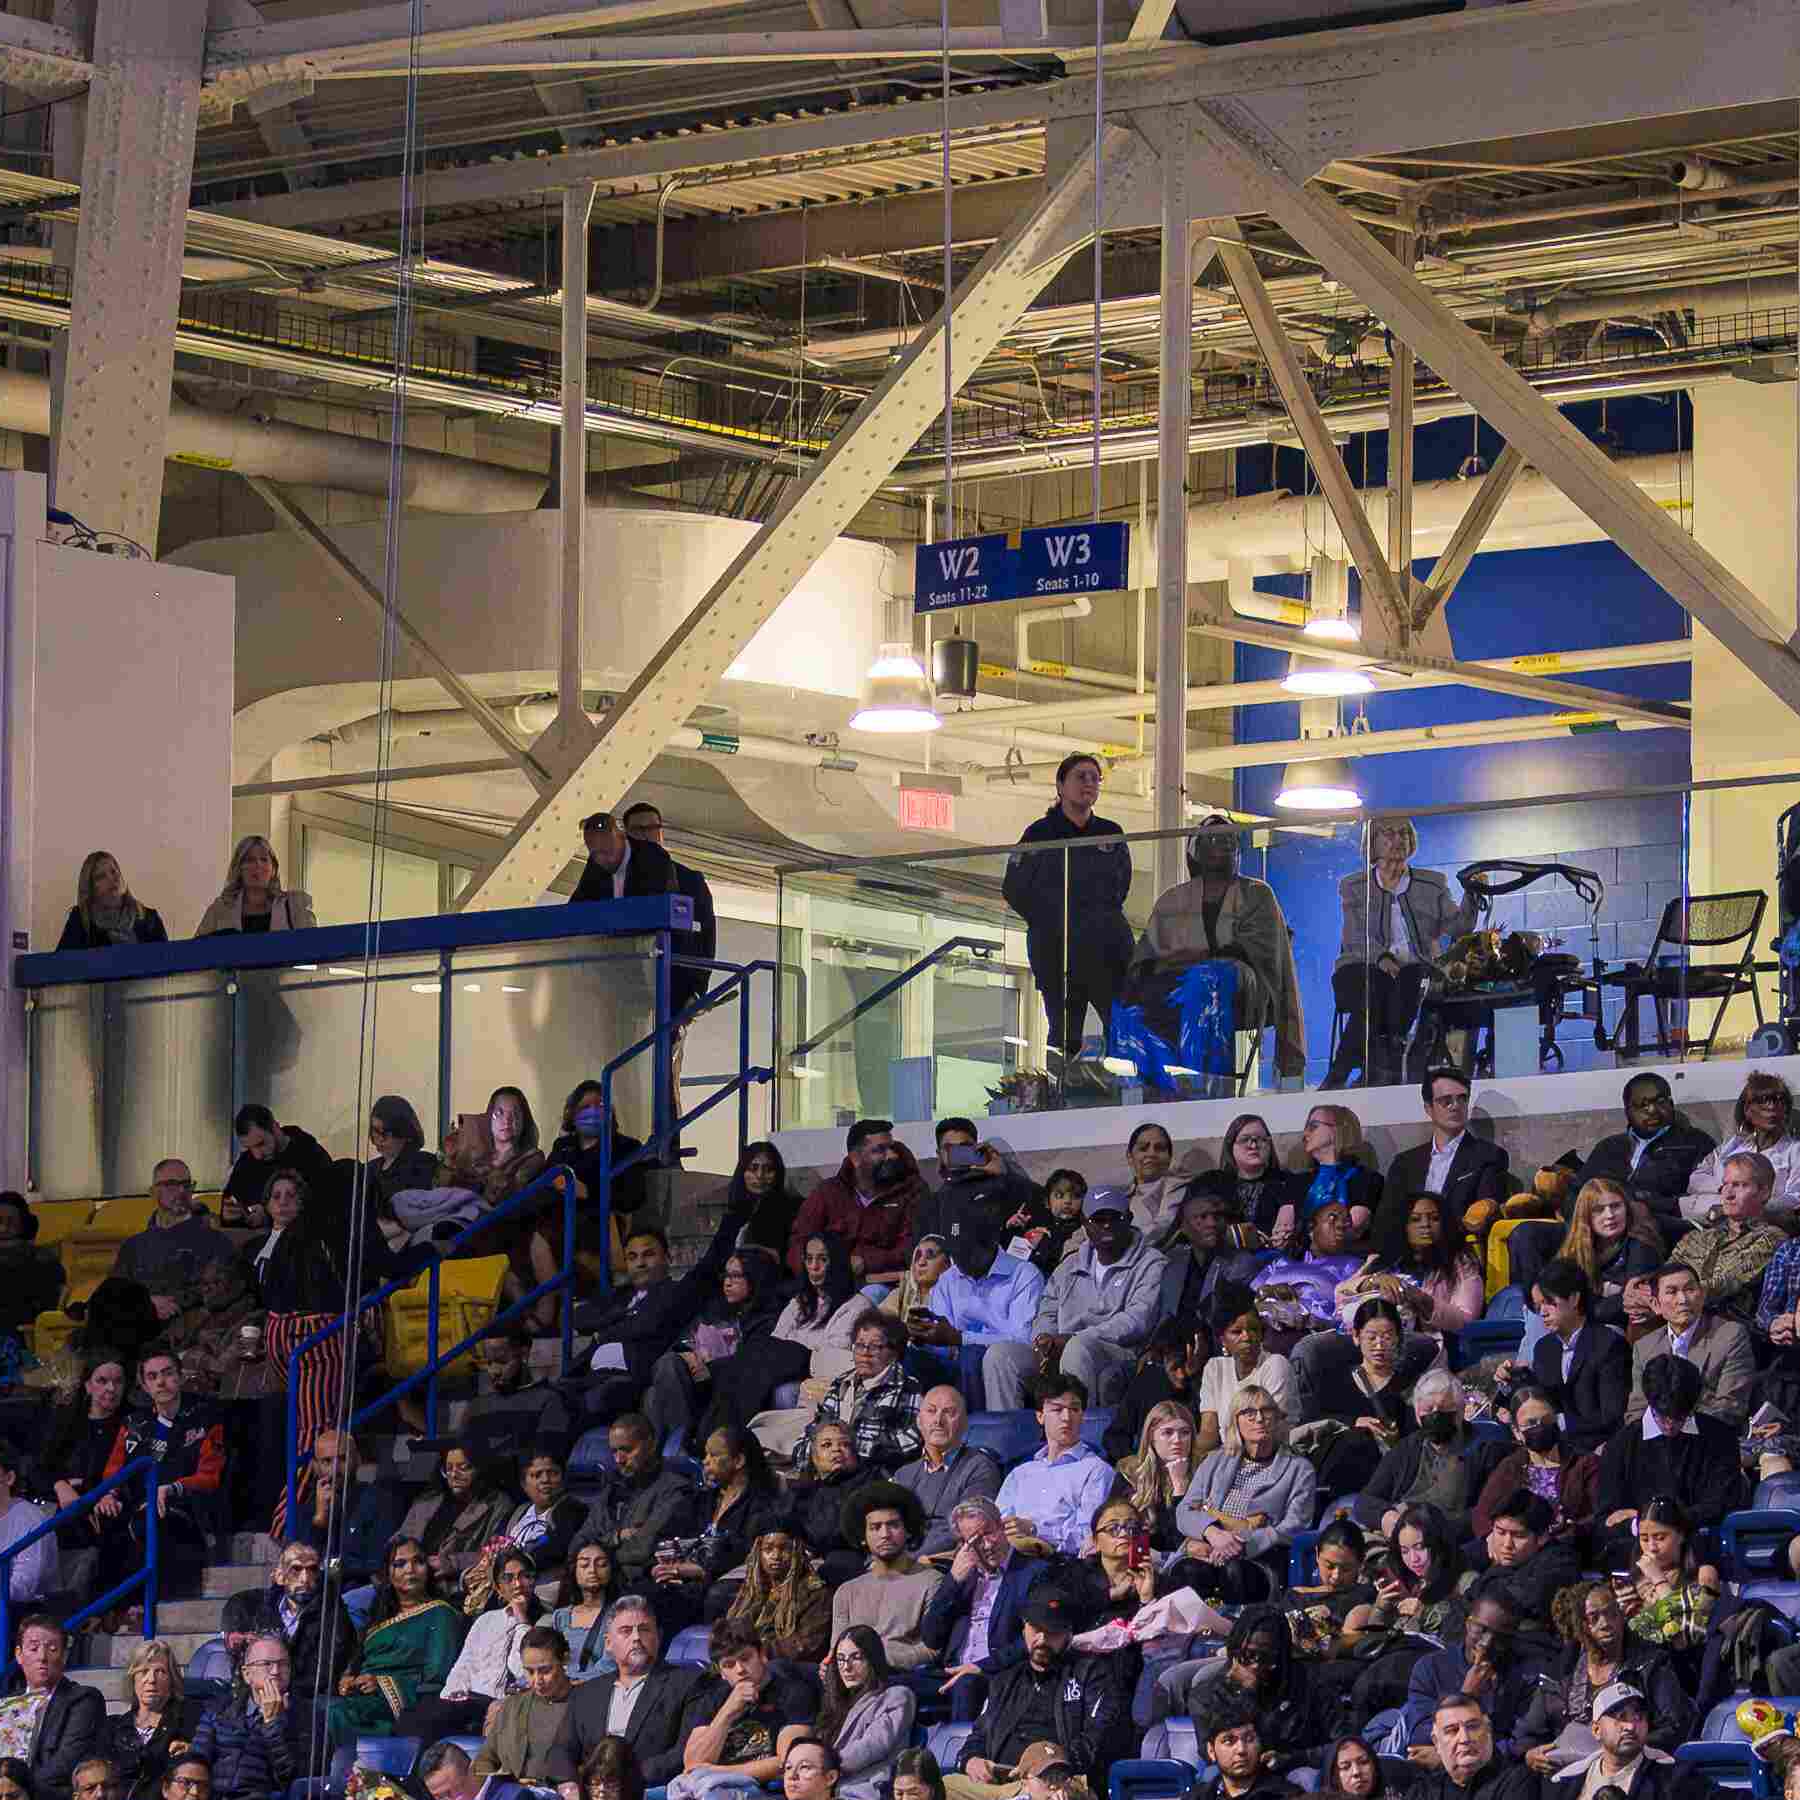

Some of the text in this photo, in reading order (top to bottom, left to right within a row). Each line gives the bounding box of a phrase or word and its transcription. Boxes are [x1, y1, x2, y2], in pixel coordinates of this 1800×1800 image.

[938, 546, 981, 582] W2
[1045, 532, 1092, 568] W3
[928, 584, 989, 607] Seats 11-22
[1036, 572, 1100, 592] Seats 1-10
